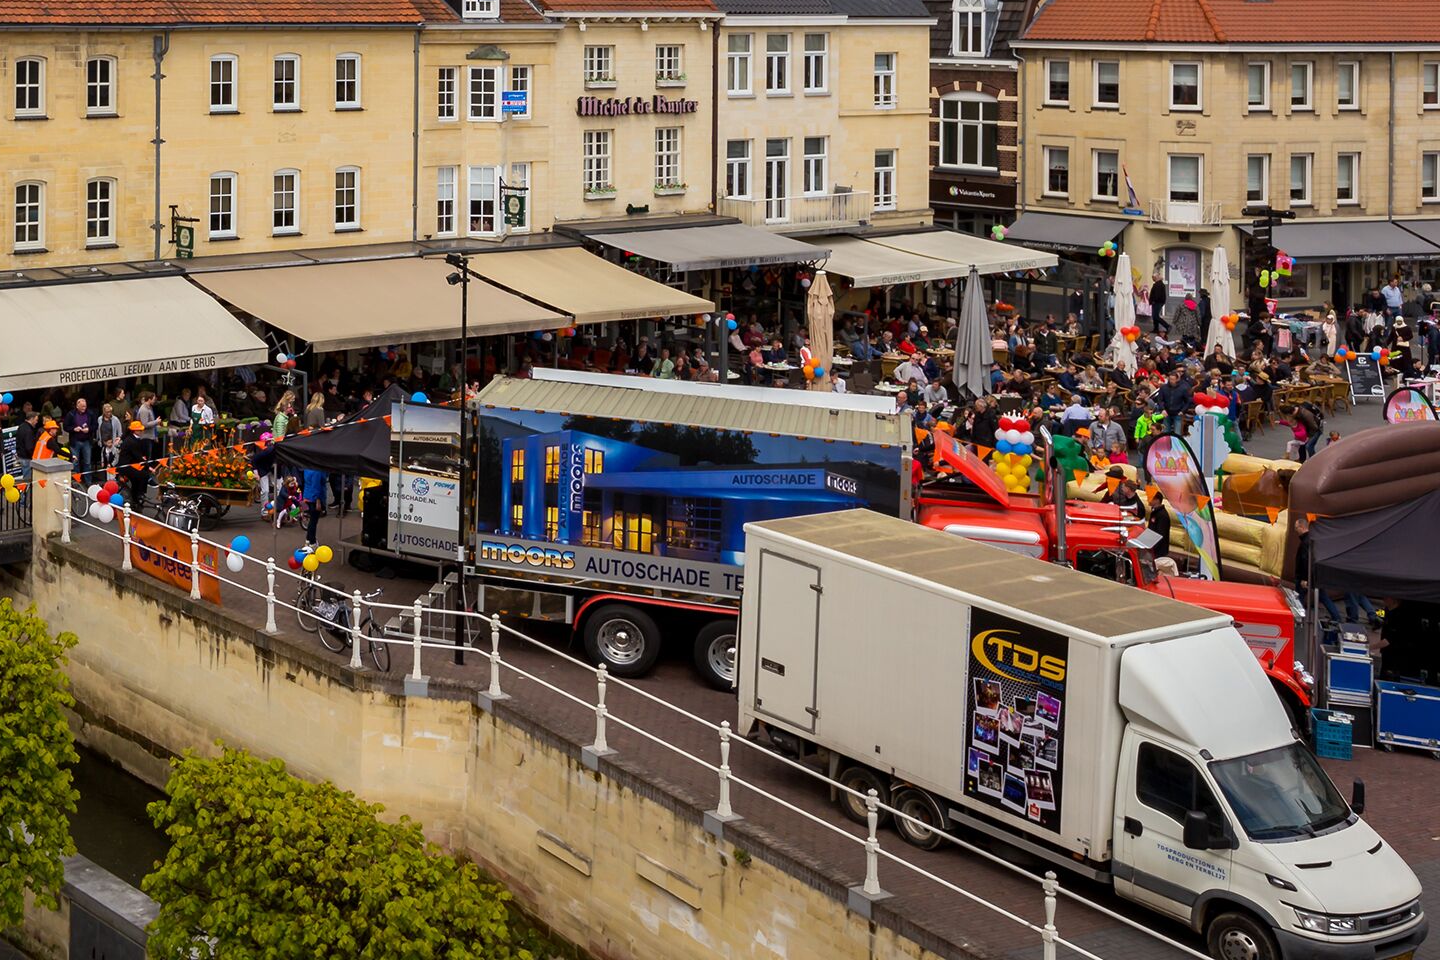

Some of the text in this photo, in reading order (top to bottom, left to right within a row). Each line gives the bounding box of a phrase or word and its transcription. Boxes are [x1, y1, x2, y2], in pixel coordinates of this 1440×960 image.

[577, 97, 632, 116] Michiel
[634, 97, 652, 114] de
[1000, 260, 1038, 271] CUP&VINO
[881, 273, 921, 284] CUP&VINO
[59, 356, 216, 383] PROEFLOKAAL LEEUW AAN DE BRUG
[560, 443, 569, 529] AUTOSCHADE
[570, 443, 583, 513] MOORS
[732, 474, 816, 485] AUTOSCHADE
[827, 475, 857, 494] MOORS
[414, 515, 423, 523] 09
[393, 533, 458, 553] AUTOSCHADE
[481, 540, 576, 570] MOORS
[585, 556, 710, 588] AUTOSCHADE
[987, 637, 1066, 681] TDS
[1157, 843, 1226, 874] TDSPRODUCTIONS.NL
[1167, 854, 1226, 880] BERG EN TERBLIJT
